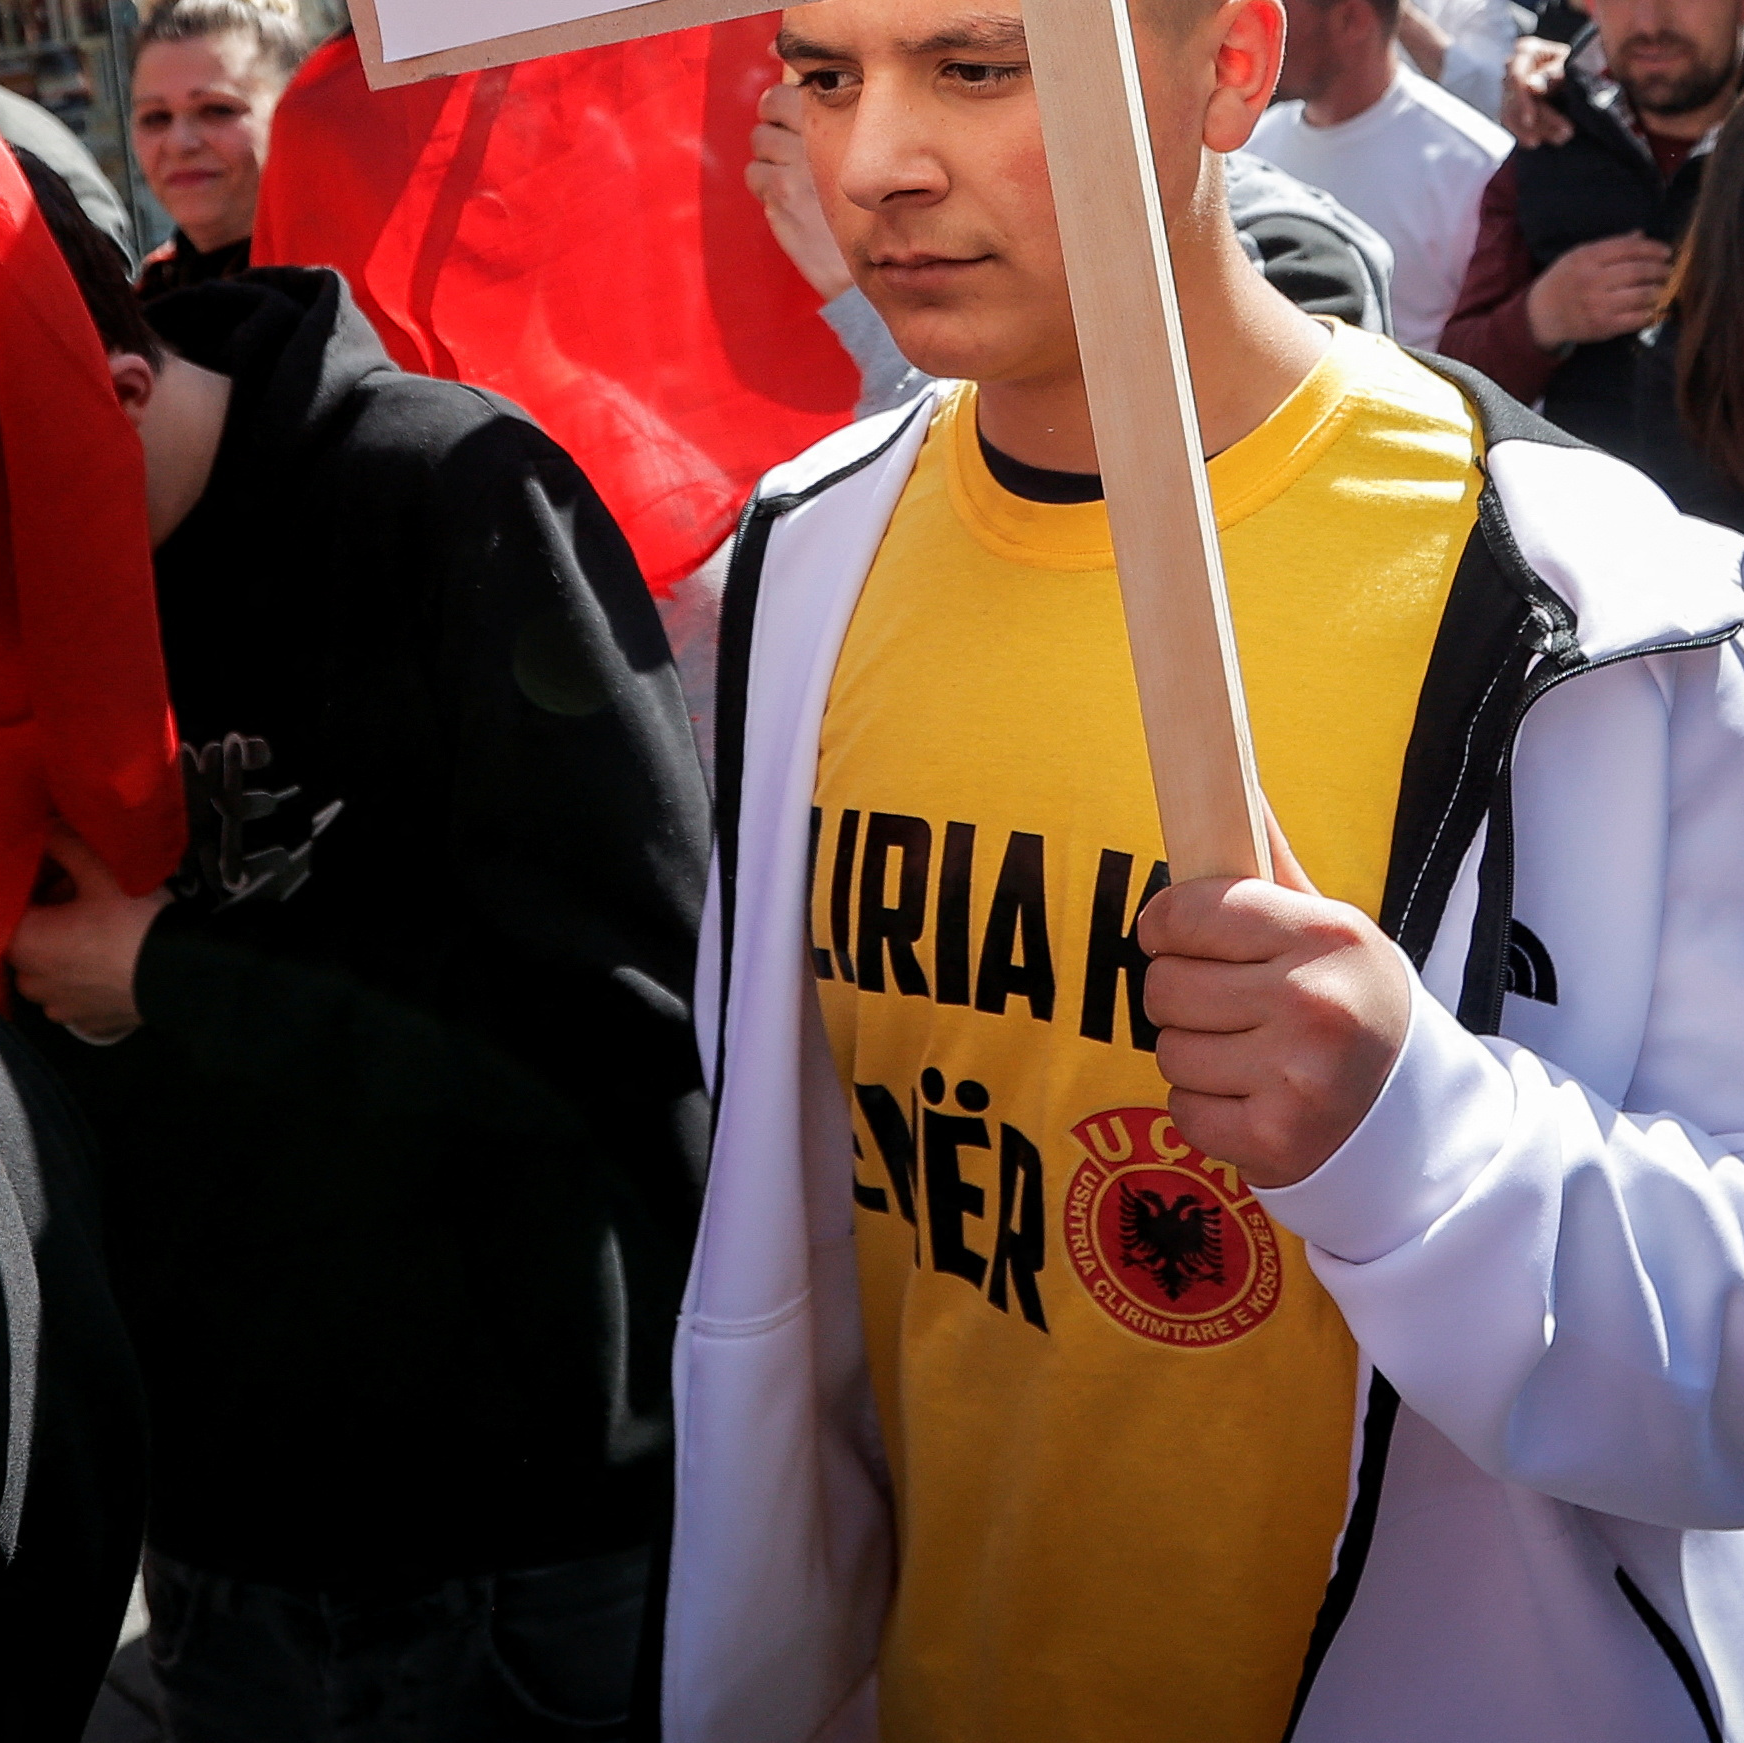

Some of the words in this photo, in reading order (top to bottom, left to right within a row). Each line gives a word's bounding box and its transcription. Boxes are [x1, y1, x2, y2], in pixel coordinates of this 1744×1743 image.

[1079, 848, 1172, 1054] K
[1069, 1170, 1100, 1277] USHTRIA
[1093, 1278, 1235, 1343] ÇLIRIMTARE
[1231, 1308, 1254, 1328] E
